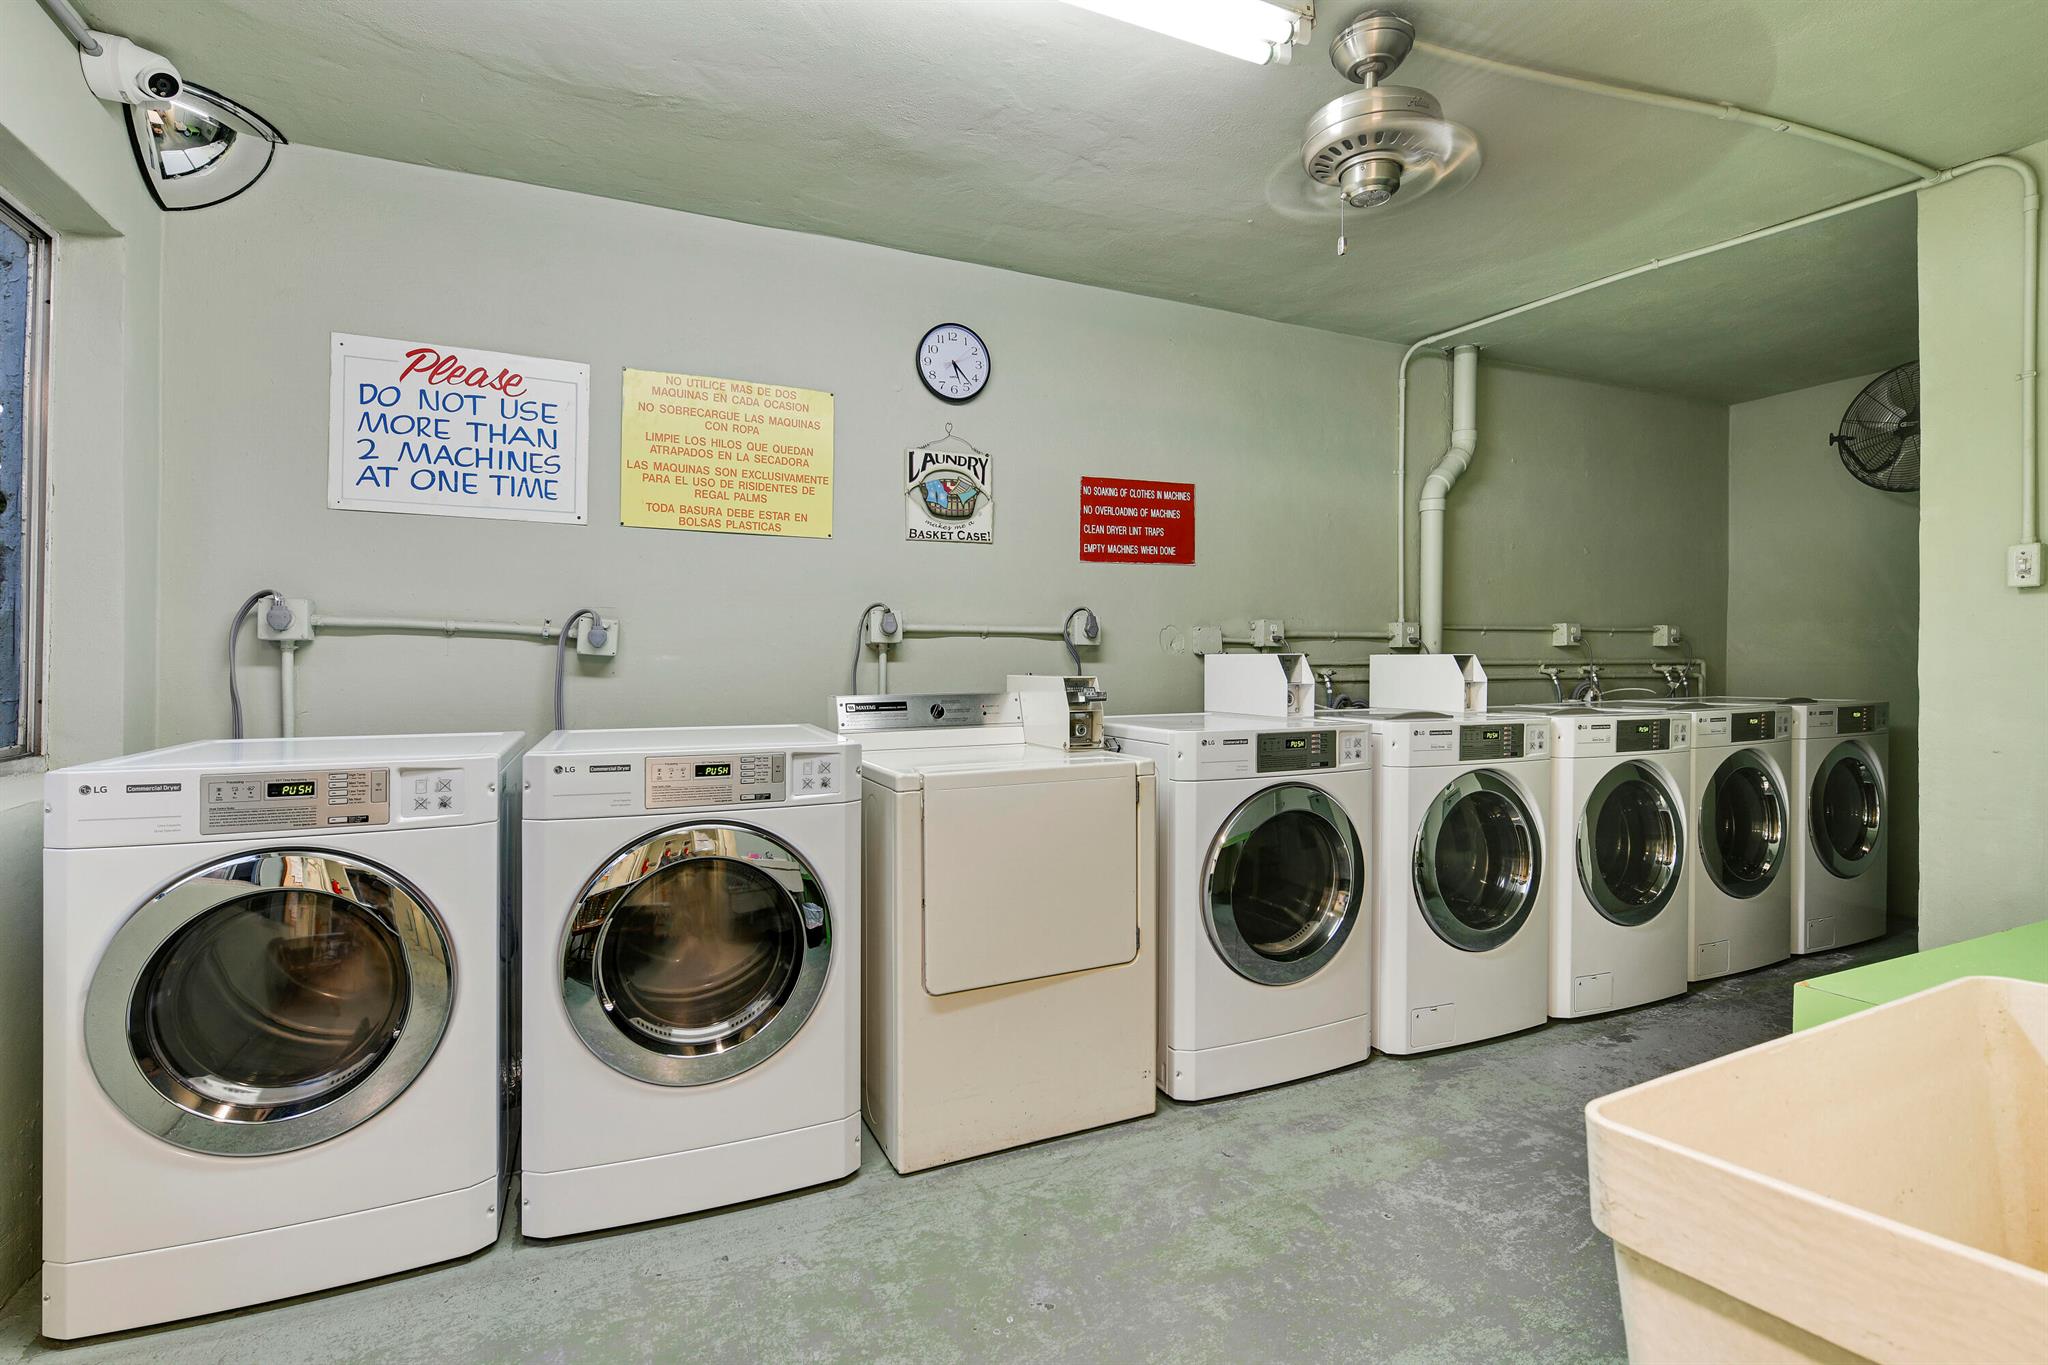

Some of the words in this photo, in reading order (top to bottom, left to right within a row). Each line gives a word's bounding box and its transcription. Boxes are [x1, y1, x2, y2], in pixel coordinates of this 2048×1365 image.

[937, 335, 944, 343] 11
[948, 332, 957, 341] 12
[964, 337, 967, 346] 1
[928, 345, 938, 354] 10
[971, 347, 978, 355] 2
[924, 357, 931, 365] 9
[976, 361, 982, 369] 3
[400, 348, 528, 398] Please
[929, 370, 936, 379] 8
[666, 376, 682, 386] NO
[686, 379, 725, 391] UTILICE
[731, 384, 753, 394] MAS
[758, 387, 771, 396] DE
[775, 390, 797, 400] DOS
[939, 381, 945, 389] 7
[951, 385, 958, 394] 6
[963, 383, 970, 391] 5
[359, 383, 400, 406] DO
[419, 389, 486, 415] NOT
[501, 398, 558, 424] USE
[651, 386, 709, 400] MAQUINAS
[713, 393, 728, 402] EN
[732, 396, 759, 407] CADA
[764, 400, 809, 412] OCASION
[638, 402, 654, 412] NO
[660, 405, 740, 421] SOBRECARGUE
[744, 414, 764, 424] LAS
[769, 417, 821, 430] MAQUINAS
[358, 411, 450, 439] MORE
[466, 422, 558, 449] THAN
[705, 421, 729, 431] CON
[733, 424, 760, 435] ROPA
[645, 432, 679, 443] LIMPIE
[685, 436, 706, 446] LOS
[711, 439, 742, 449] HILOS
[747, 442, 768, 452] QUE
[772, 445, 814, 456] QUEDAN
[356, 439, 379, 460] 2
[398, 442, 561, 474] MACHINES
[650, 445, 713, 459] ATRAPADOS
[718, 451, 732, 460] EN
[736, 453, 750, 462] LA
[754, 455, 809, 467] SECADORA
[626, 460, 648, 470] LAS
[653, 462, 709, 475] MAQUINAS
[715, 468, 737, 477] SON
[742, 470, 829, 485] EXCLUSIVAMENTE
[909, 452, 988, 485] LAUNDRY
[356, 466, 398, 487] AT
[410, 469, 478, 494] ONE
[489, 474, 558, 500] TIME
[642, 474, 670, 483] PARA
[675, 476, 688, 485] EL
[692, 478, 715, 487] USO
[720, 480, 734, 489] DE
[738, 482, 798, 494] RISIDENTES
[802, 487, 815, 495] DE
[694, 489, 729, 500] REGAL
[734, 493, 767, 503] PALMS
[1083, 486, 1091, 495] NO
[1094, 487, 1118, 496] SOAKING
[1120, 489, 1128, 497] OF
[1130, 489, 1155, 499] CLOTHES
[1157, 491, 1162, 499] IN
[1164, 491, 1190, 501] MACHINES
[646, 503, 675, 513] TODA
[680, 506, 722, 516] BASURA
[727, 508, 754, 518] DEBE
[759, 511, 790, 521] ESTAR
[794, 513, 808, 522] EN
[1083, 506, 1092, 514] NO
[1095, 506, 1138, 516] OVERLOADING
[1140, 508, 1148, 517] OF
[1151, 509, 1180, 519] MACHINES
[679, 517, 721, 528] BOLSAS
[726, 520, 781, 532] PLASTICAS
[925, 520, 952, 530] makes
[1084, 524, 1104, 534] CLEAN
[1107, 526, 1127, 535] DRYER
[1129, 527, 1142, 535] LINT
[1145, 527, 1164, 536] TRAPS
[909, 528, 953, 540] BASKET
[957, 531, 990, 541] CASE!
[1084, 544, 1105, 552] EMPTY
[1108, 545, 1138, 554] MACHINES
[1141, 546, 1158, 554] WHEN
[1160, 547, 1176, 555] DONE
[706, 767, 729, 775] PUSH
[282, 786, 313, 795] PUSH
